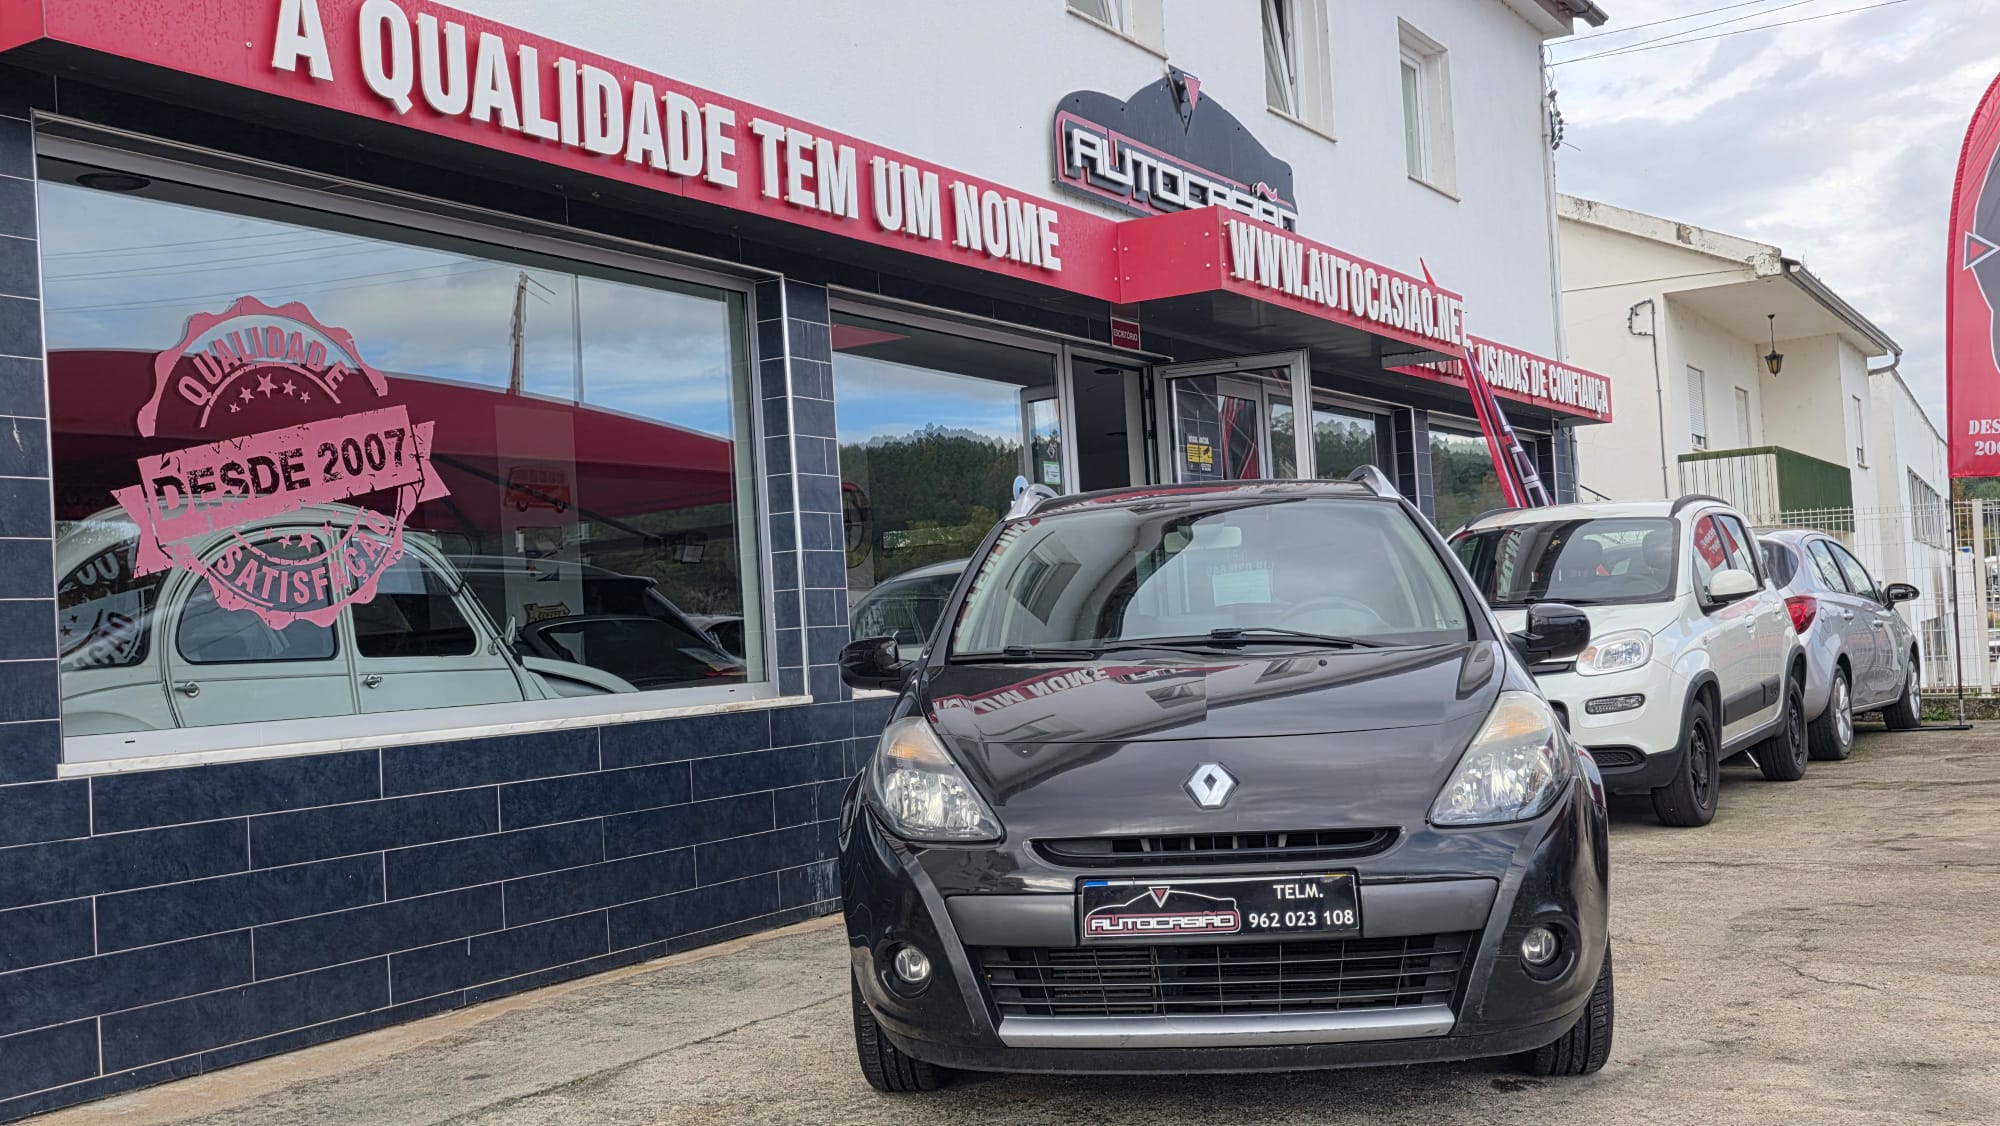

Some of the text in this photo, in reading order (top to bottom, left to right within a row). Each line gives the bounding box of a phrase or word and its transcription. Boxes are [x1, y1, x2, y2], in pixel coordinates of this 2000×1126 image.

[272, 0, 1063, 272] A QUALIDADE TEM UM NOME
[1230, 218, 1467, 347] WWW.AUTOCASIAO.NET
[177, 325, 350, 407] QUALIDADE
[1477, 342, 1610, 419] USADAS DE CONFIANÇA
[152, 428, 407, 520] DESDE 2007
[1248, 909, 1354, 928] 962 023 108
[1272, 883, 1325, 900] TELM.
